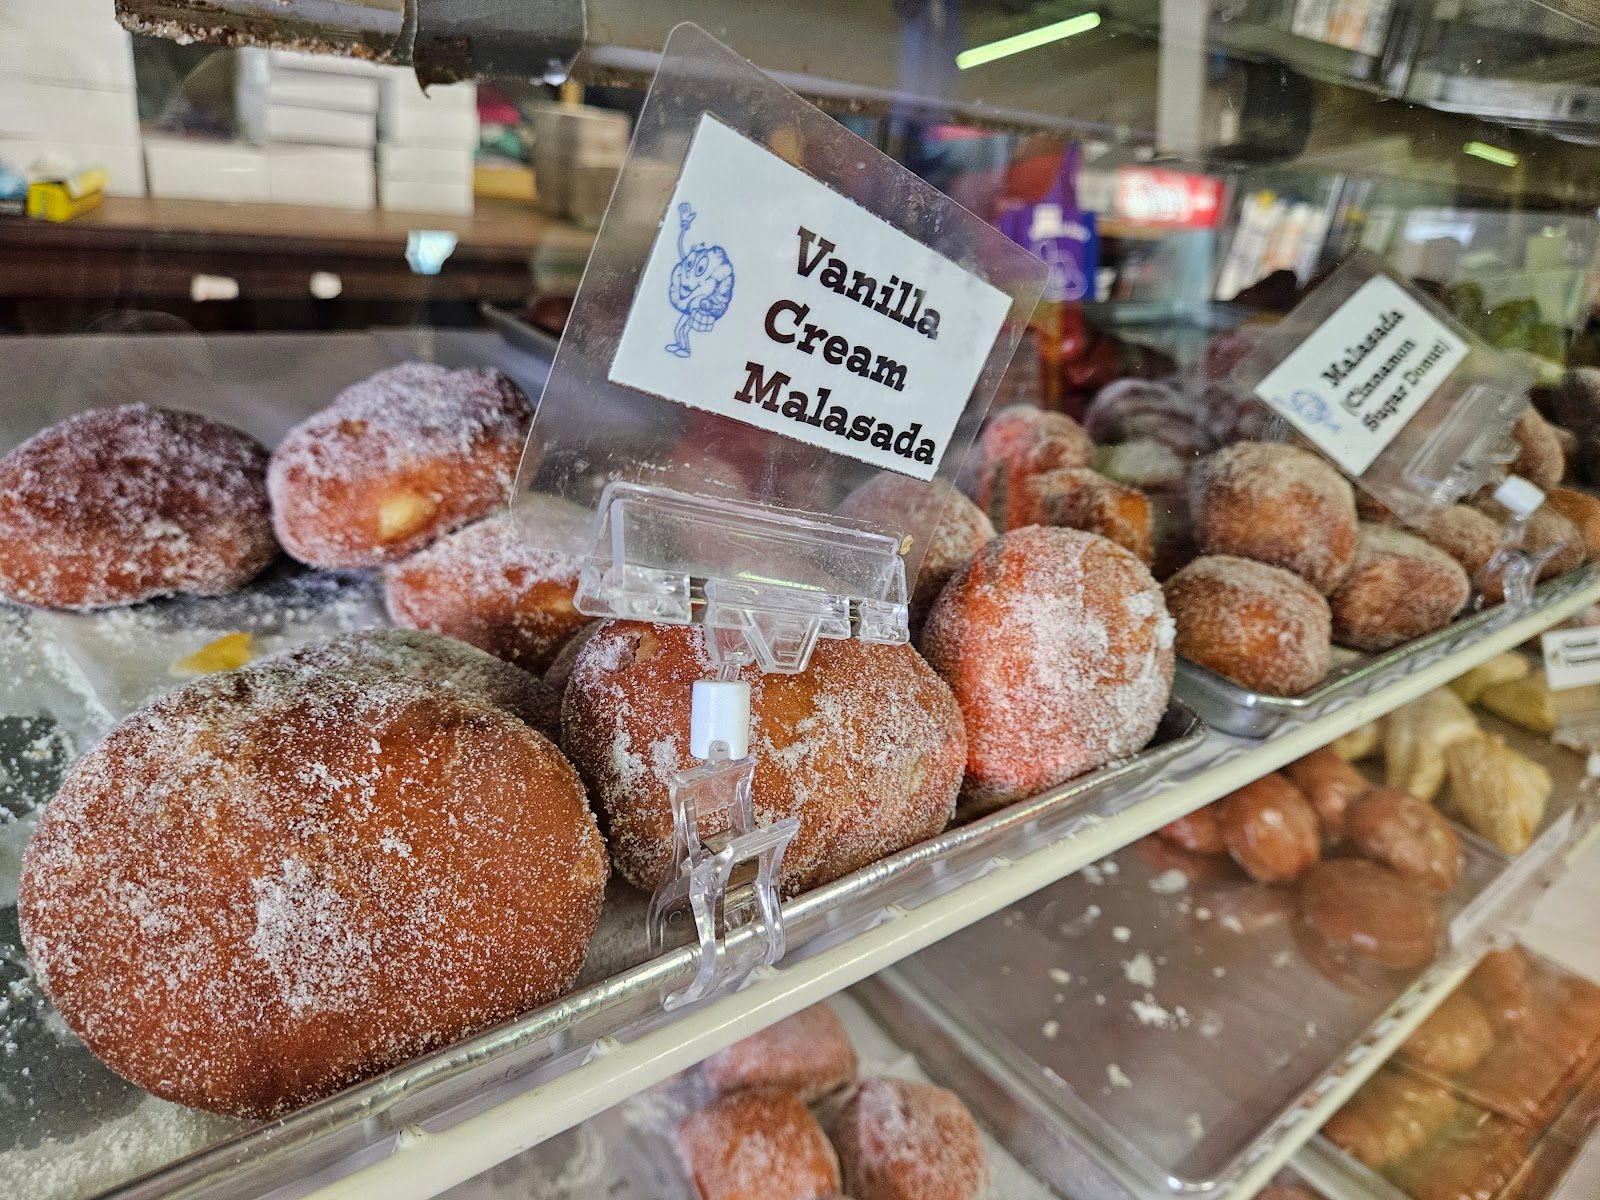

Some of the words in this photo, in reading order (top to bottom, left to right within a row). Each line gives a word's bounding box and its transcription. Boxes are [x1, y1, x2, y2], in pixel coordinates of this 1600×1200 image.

[796, 225, 941, 340] Vanilla
[764, 298, 909, 392] Cream
[1321, 310, 1405, 387] Malasada
[733, 361, 937, 465] Malasada
[1362, 385, 1408, 432] Sugar
